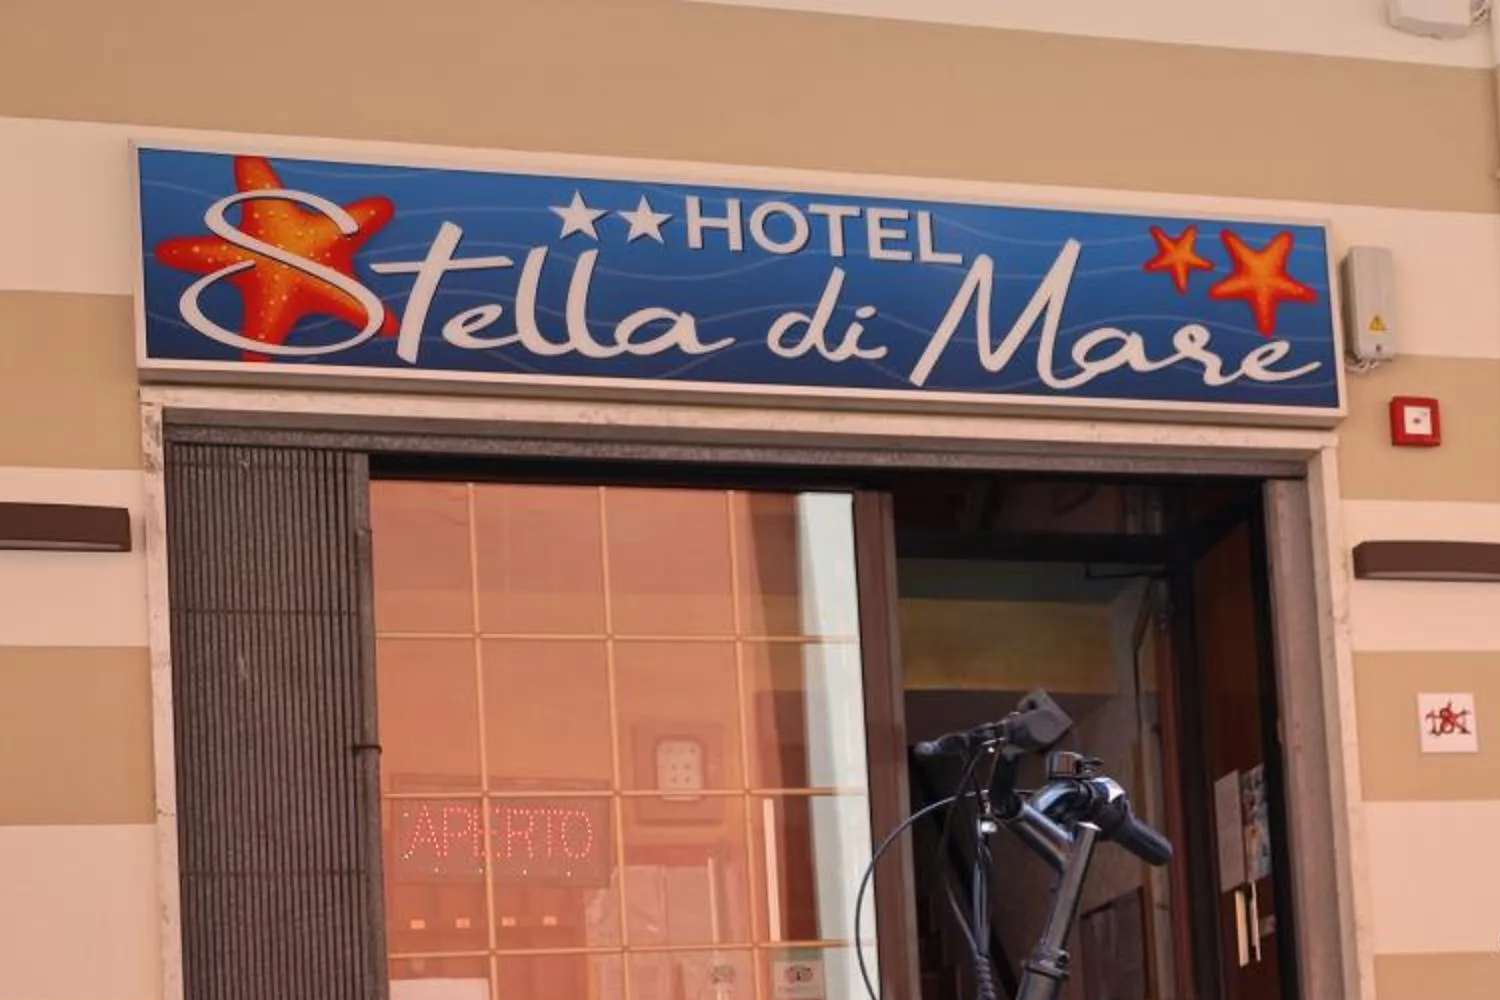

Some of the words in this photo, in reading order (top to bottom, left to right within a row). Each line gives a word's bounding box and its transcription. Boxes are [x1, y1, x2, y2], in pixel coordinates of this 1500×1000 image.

[685, 195, 964, 265] HOTEL
[179, 189, 736, 365] Stella
[766, 266, 888, 362] di
[908, 238, 1322, 389] Mare
[401, 802, 593, 860] APERTO
